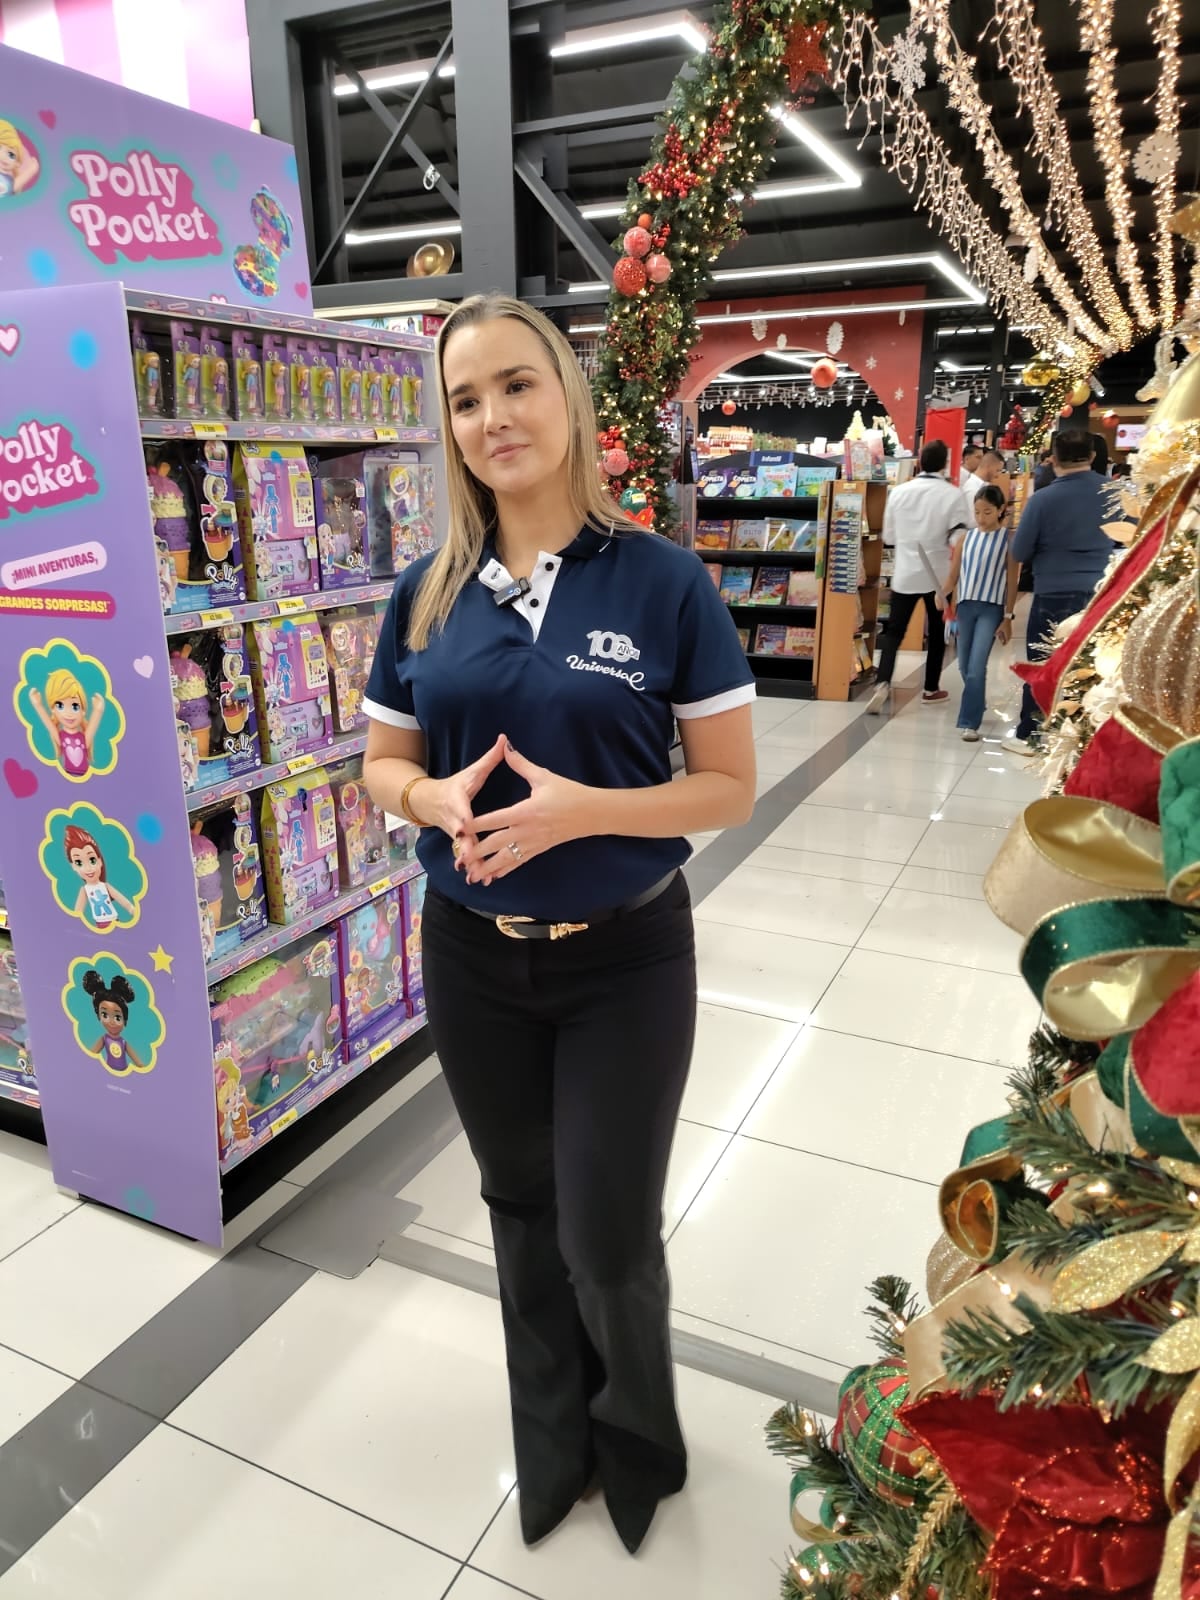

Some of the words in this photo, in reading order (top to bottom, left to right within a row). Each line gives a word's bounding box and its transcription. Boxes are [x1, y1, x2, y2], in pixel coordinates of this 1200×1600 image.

[70, 152, 179, 207] Polly
[69, 201, 210, 247] Pocket
[0, 421, 62, 464] olly
[0, 455, 87, 503] ocket
[11, 564, 38, 584] ¡MINI
[38, 551, 99, 576] AVENTURAS,
[206, 563, 238, 591] Polly
[44, 597, 108, 613] SORPRESAS!
[566, 654, 646, 691] Universal
[225, 733, 255, 758] Polly
